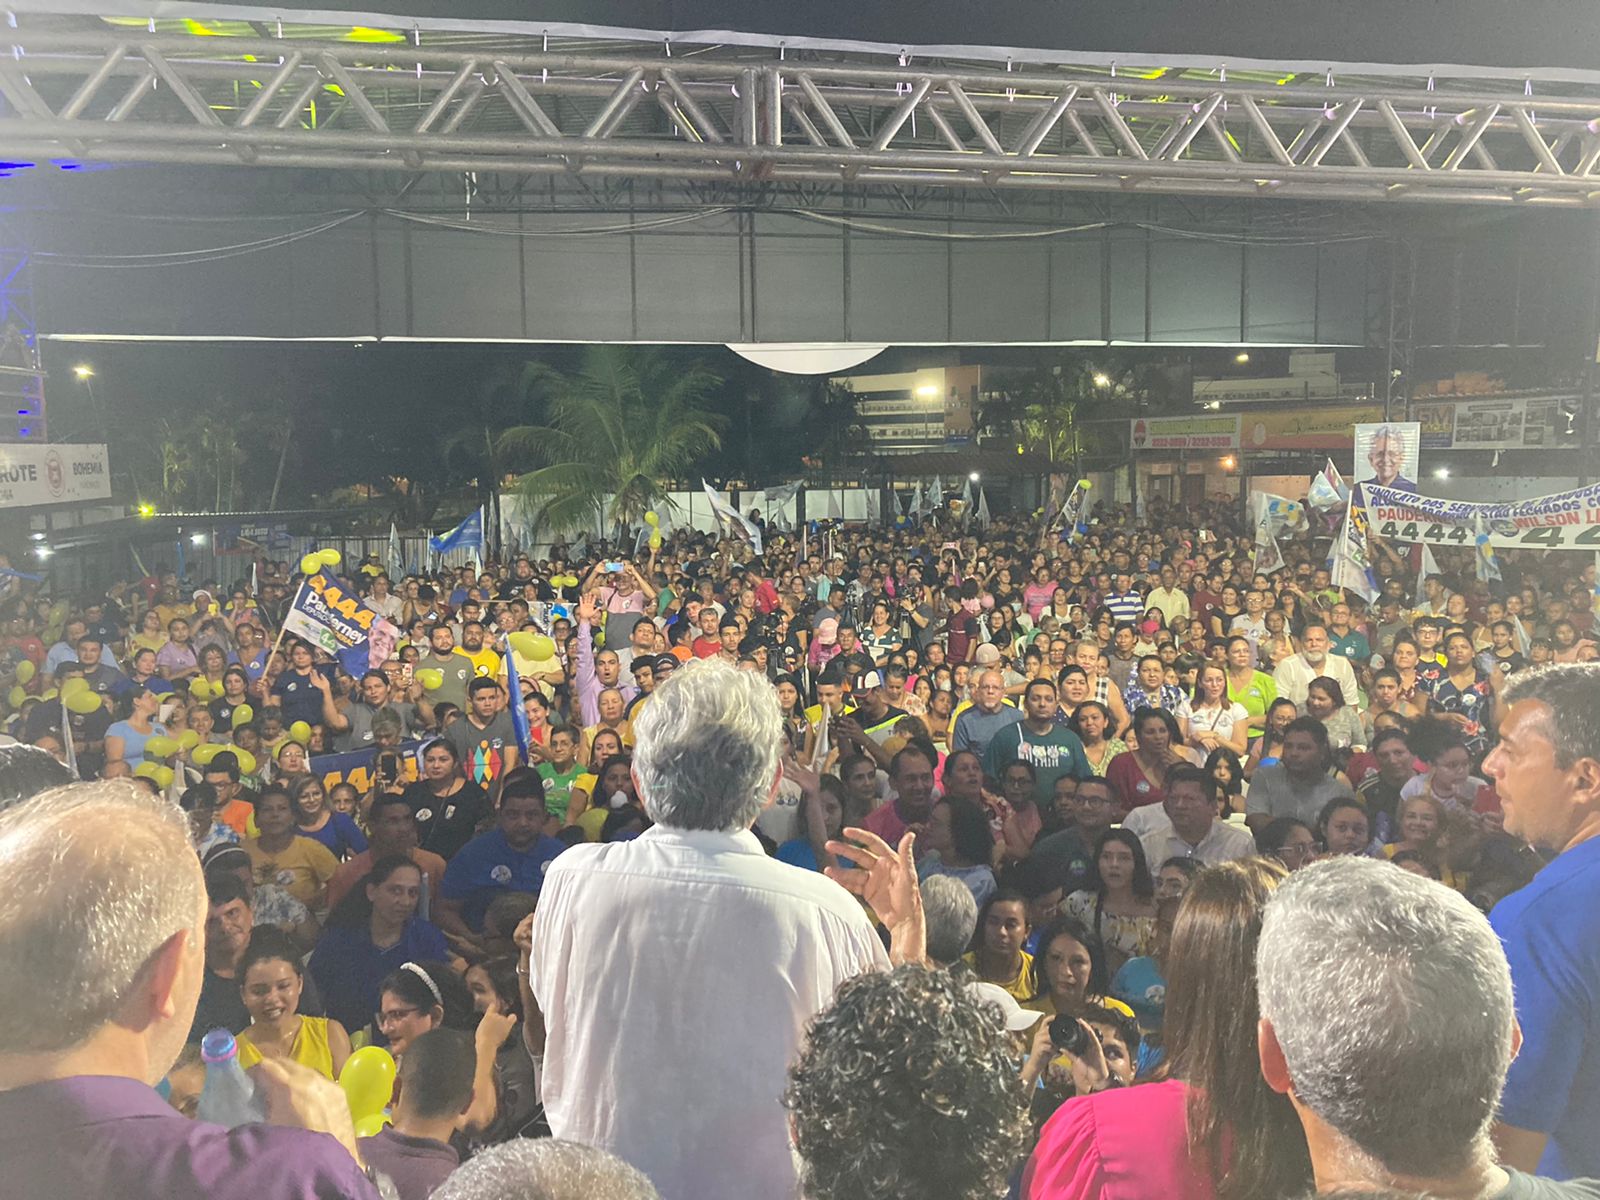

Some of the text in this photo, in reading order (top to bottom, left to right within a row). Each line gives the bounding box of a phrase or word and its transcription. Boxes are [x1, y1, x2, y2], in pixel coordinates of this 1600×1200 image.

[73, 462, 104, 476] BOHEMIA
[1367, 486, 1420, 503] SINDICATO
[1513, 501, 1581, 516] FECHADOS
[1513, 511, 1580, 529] WILSON
[308, 574, 376, 630] 4444
